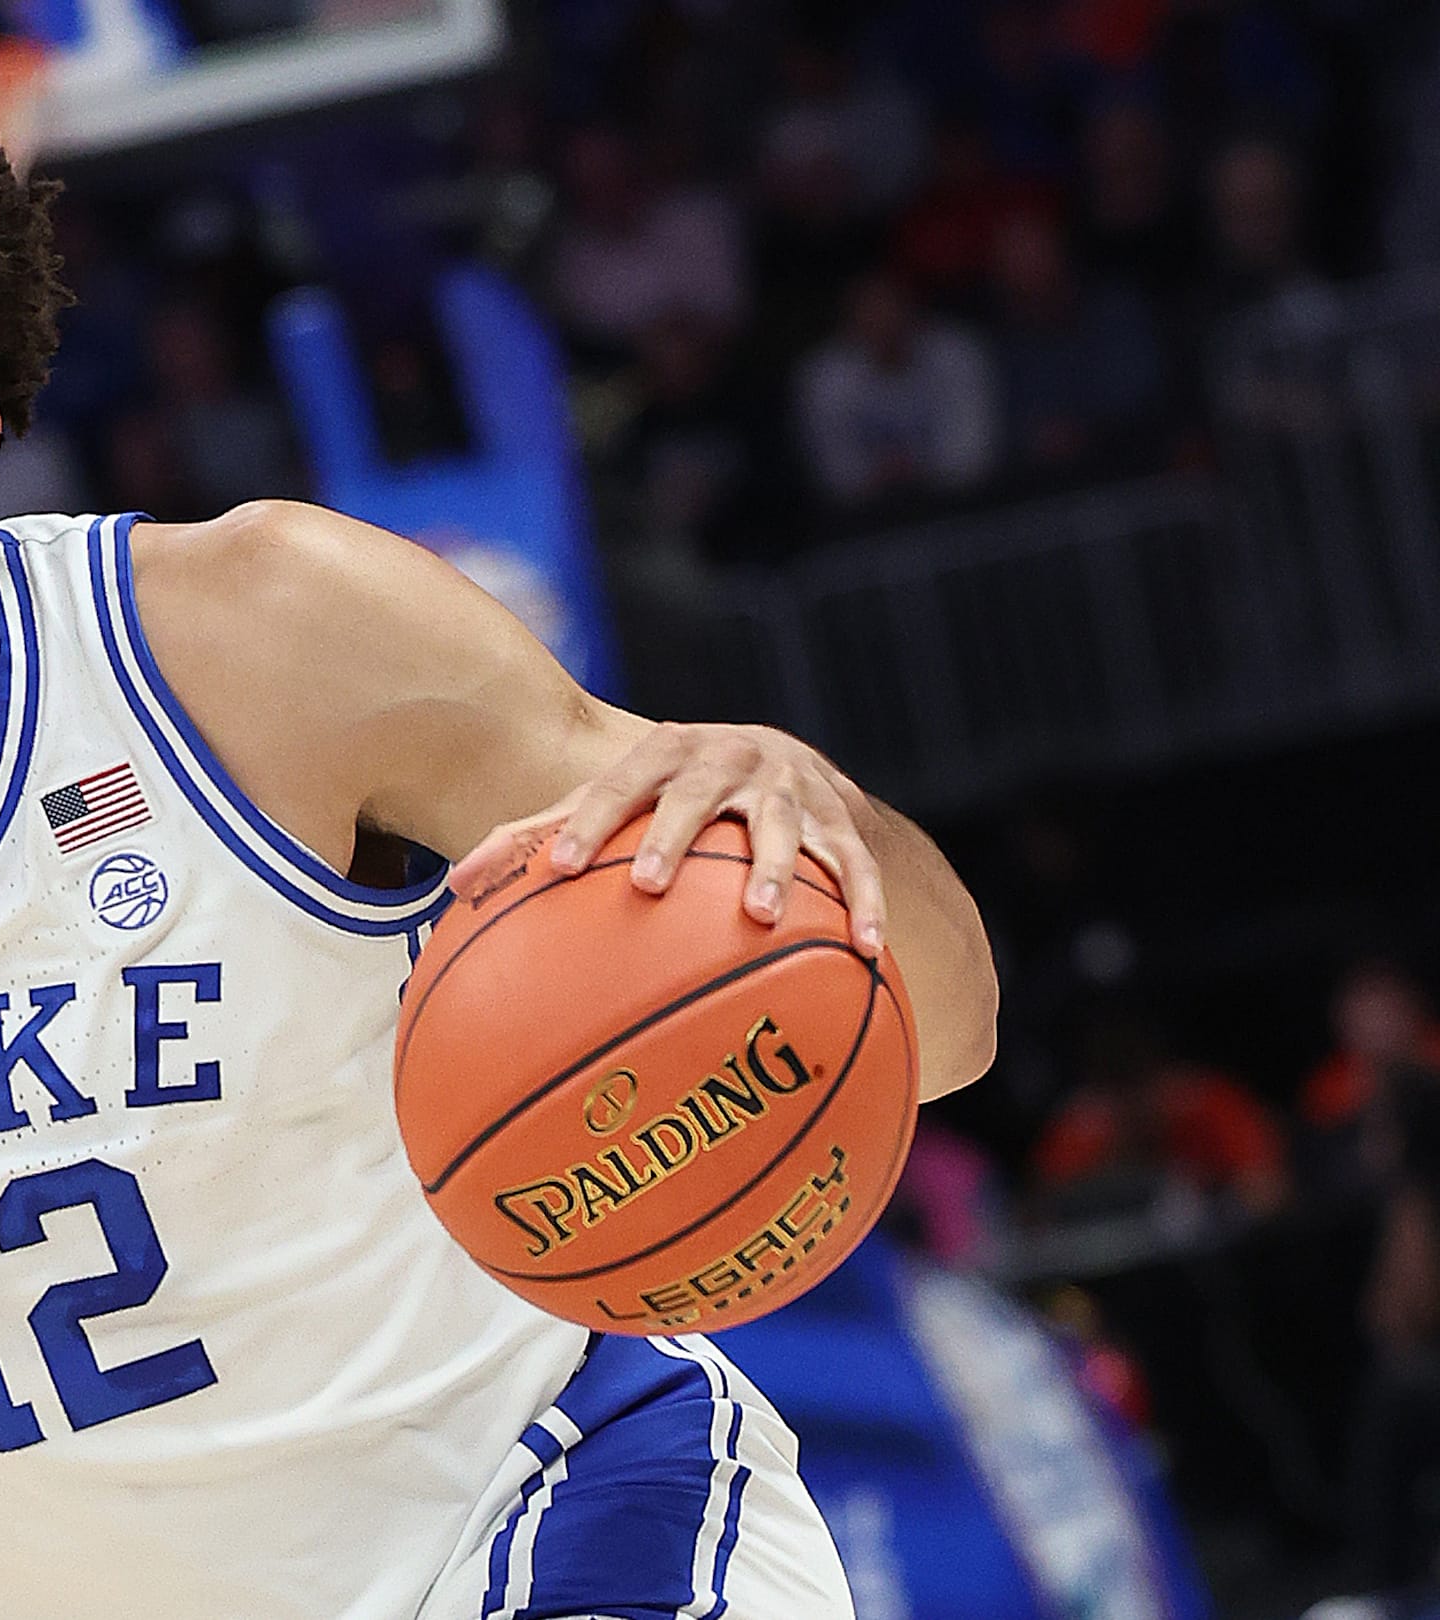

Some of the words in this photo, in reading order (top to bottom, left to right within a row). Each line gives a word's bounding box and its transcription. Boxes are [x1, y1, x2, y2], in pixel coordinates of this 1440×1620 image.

[103, 868, 158, 904] ACC
[495, 1015, 814, 1259] SPALDING
[595, 1145, 848, 1319] LEGACY
